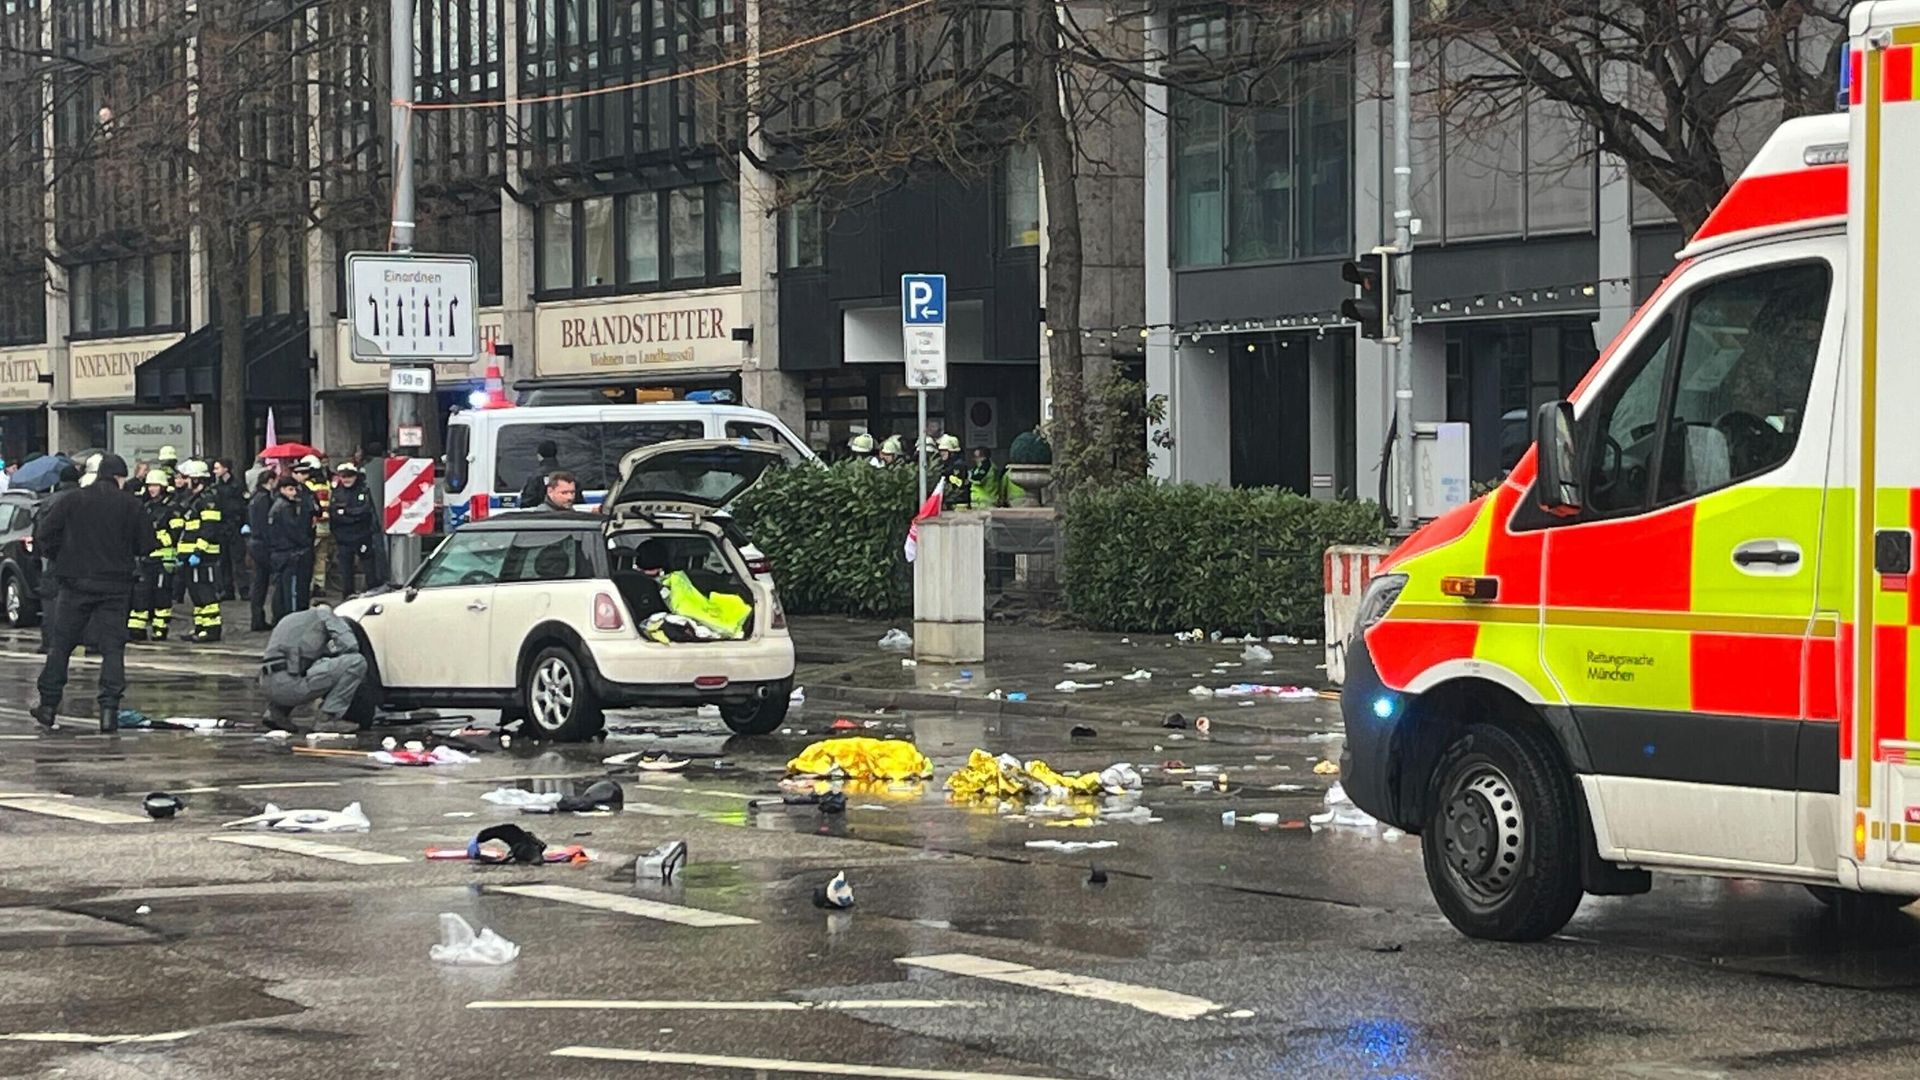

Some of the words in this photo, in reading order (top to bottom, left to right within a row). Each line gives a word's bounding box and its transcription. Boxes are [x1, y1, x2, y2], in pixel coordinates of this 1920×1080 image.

[383, 268, 442, 283] Einordnen
[909, 281, 933, 319] P
[560, 307, 726, 348] BRANDSTETTER
[397, 373, 413, 385] 150
[169, 423, 183, 435] 30
[1587, 666, 1635, 681] München
